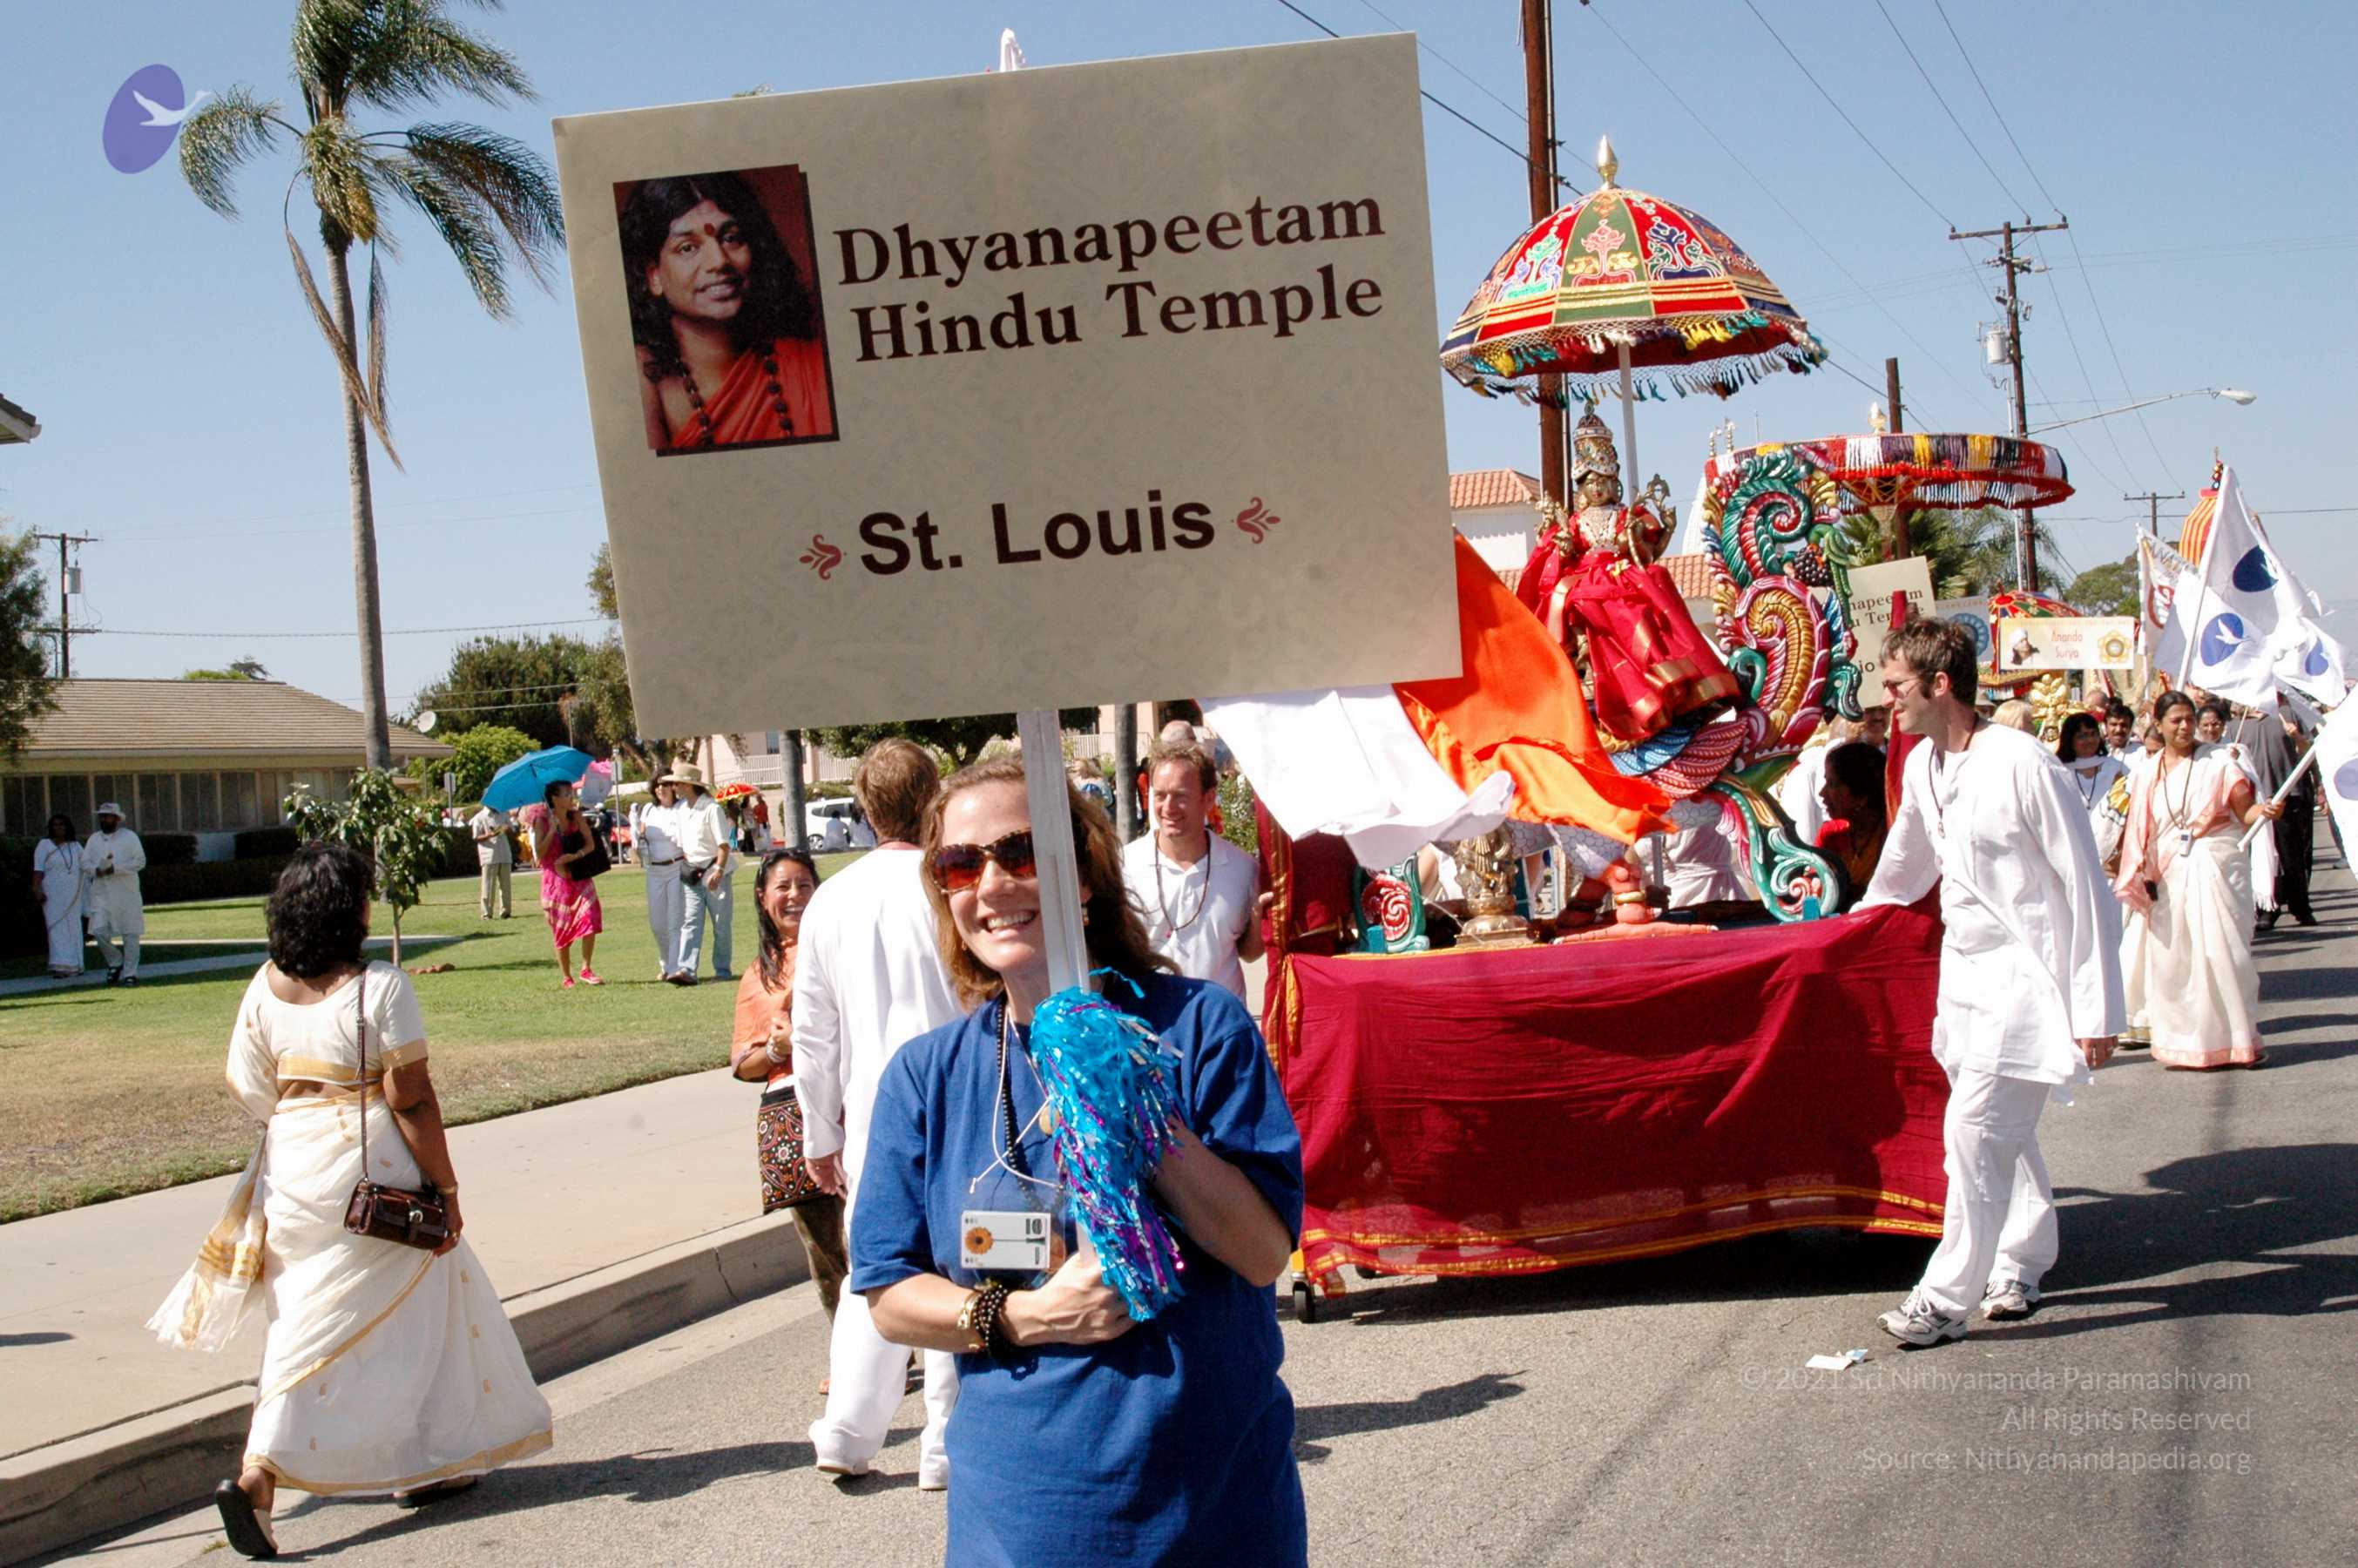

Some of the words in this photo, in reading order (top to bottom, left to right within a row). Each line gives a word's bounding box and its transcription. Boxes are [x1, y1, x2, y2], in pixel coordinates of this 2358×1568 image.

[832, 195, 1386, 288] Dhyanapeetam
[849, 292, 1083, 362] Hindu
[1105, 263, 1384, 339] Temple
[859, 510, 963, 576] St.
[991, 489, 1215, 564] Louis
